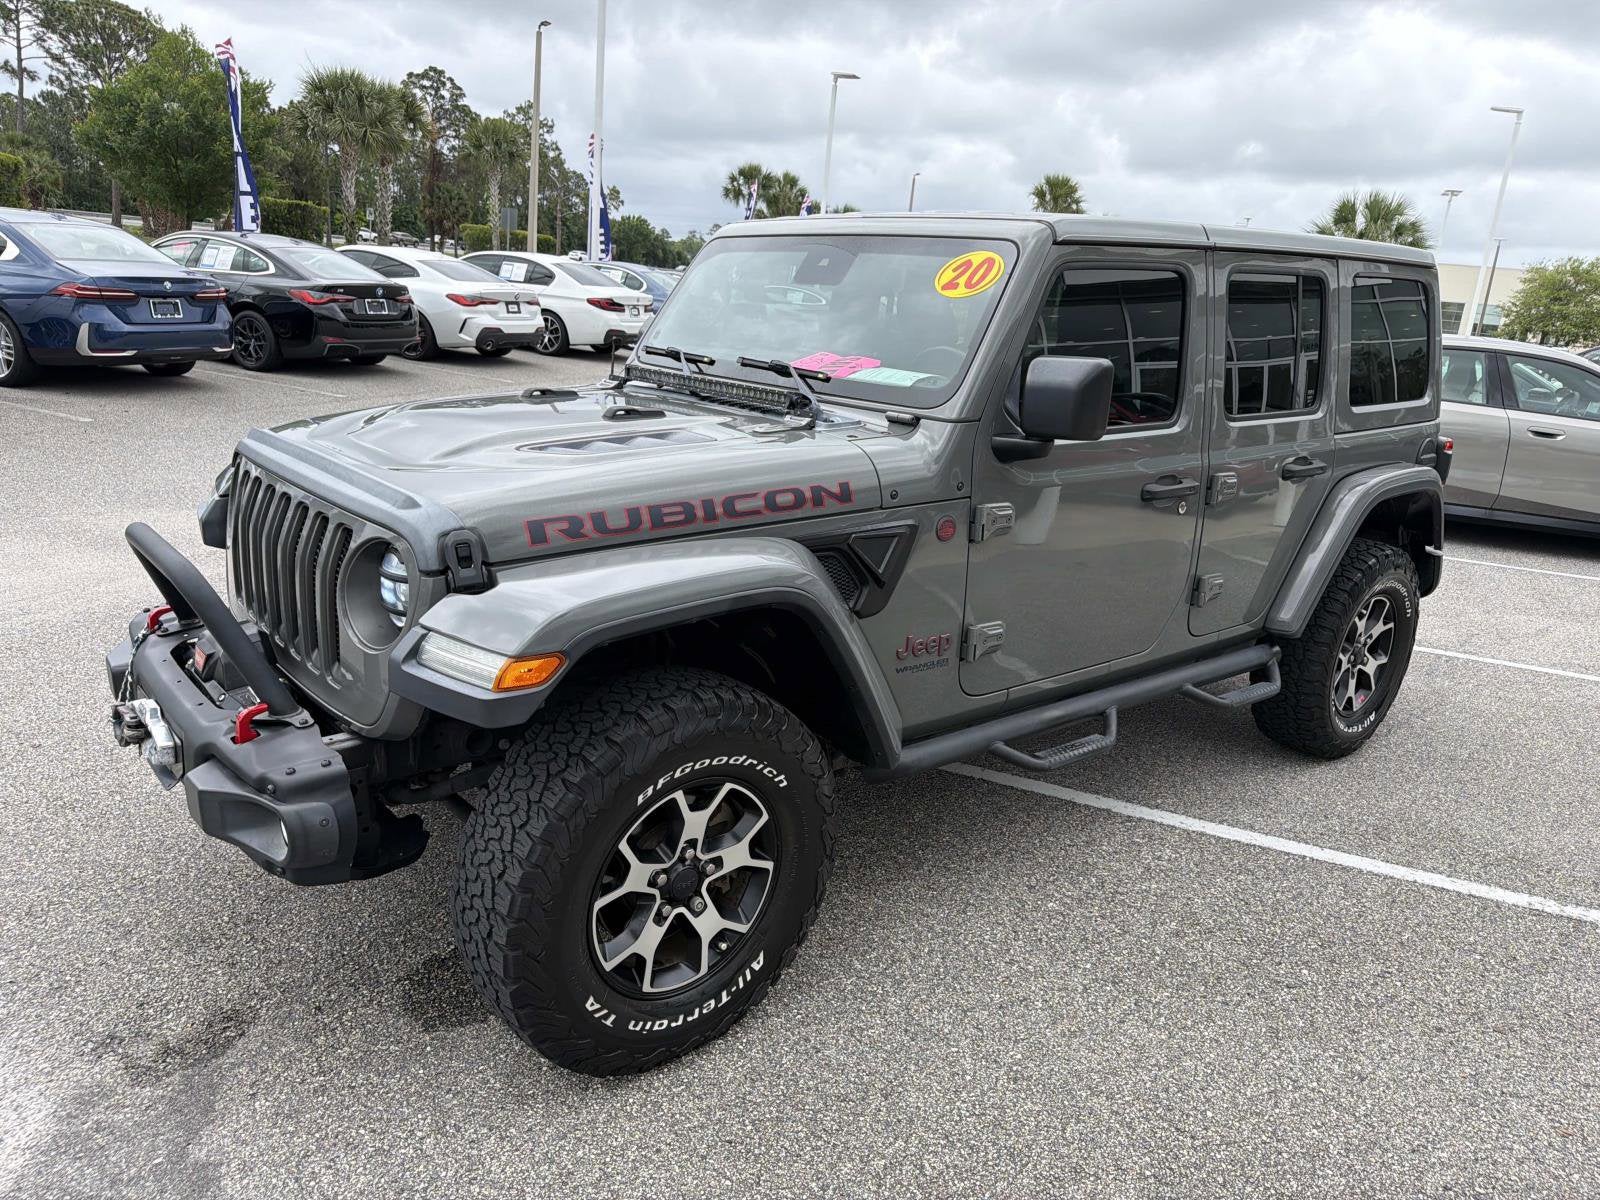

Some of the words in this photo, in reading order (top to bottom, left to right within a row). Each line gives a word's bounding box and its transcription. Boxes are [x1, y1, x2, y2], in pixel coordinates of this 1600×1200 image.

[941, 256, 996, 291] 20
[524, 481, 854, 547] RUBICON
[895, 633, 951, 660] Jeep
[636, 754, 789, 807] BFGoodrich
[584, 995, 617, 1028] T/A
[628, 949, 765, 1034] All-Terrain
